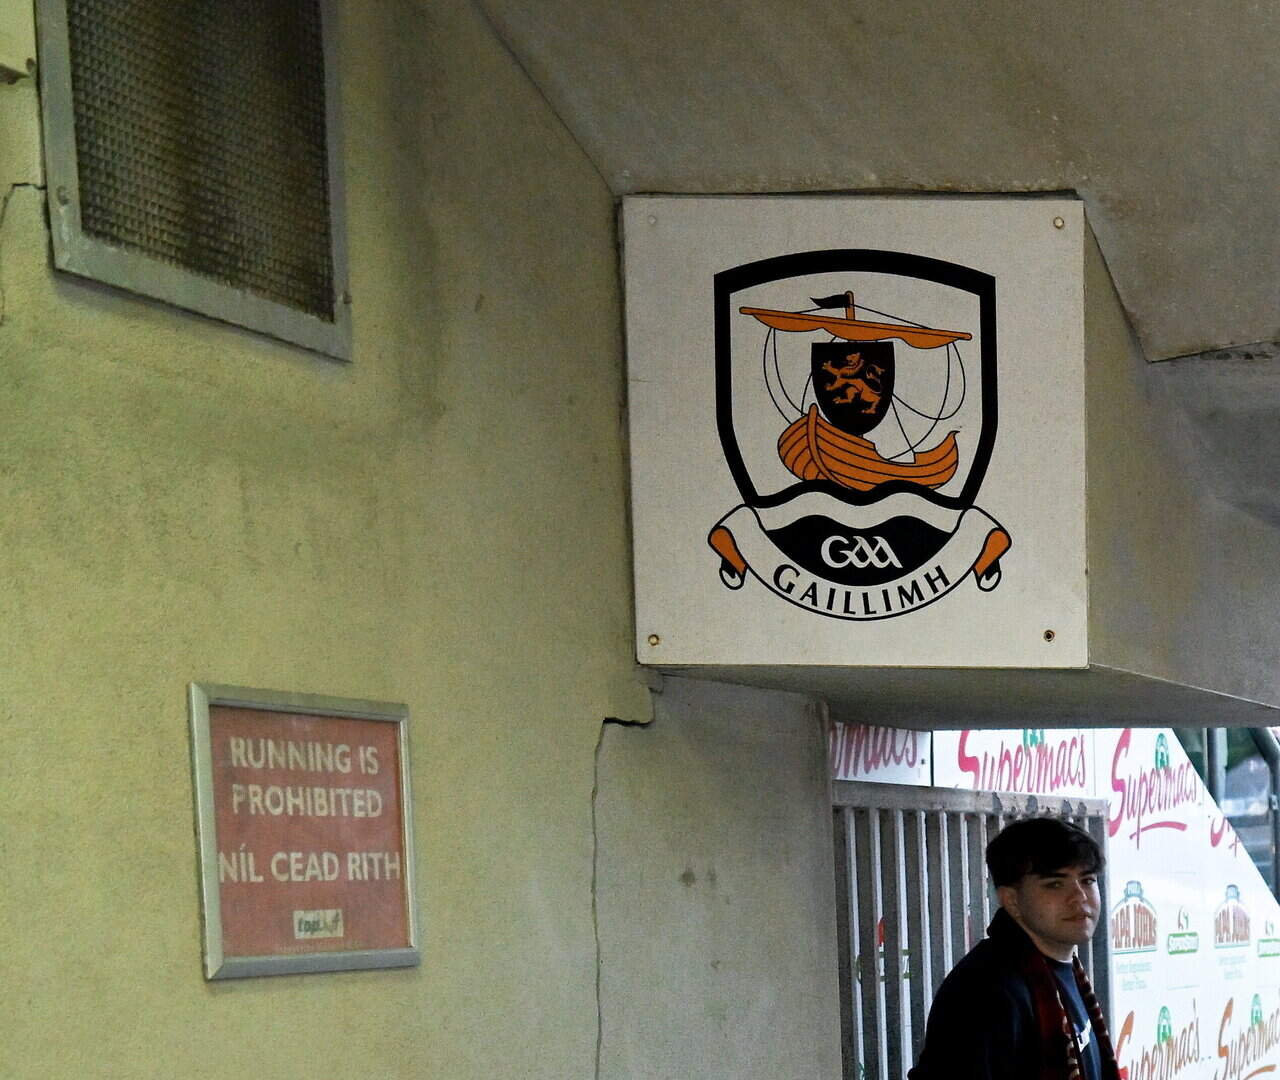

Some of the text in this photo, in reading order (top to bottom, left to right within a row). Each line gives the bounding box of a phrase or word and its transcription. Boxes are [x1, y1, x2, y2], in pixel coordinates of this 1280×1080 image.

[820, 534, 903, 569] GAA
[773, 563, 953, 615] GAILLIMH
[230, 737, 379, 775] RUNNING IS
[232, 783, 383, 818] PROHIBITED
[219, 843, 401, 883] NÍL CEAD RITH
